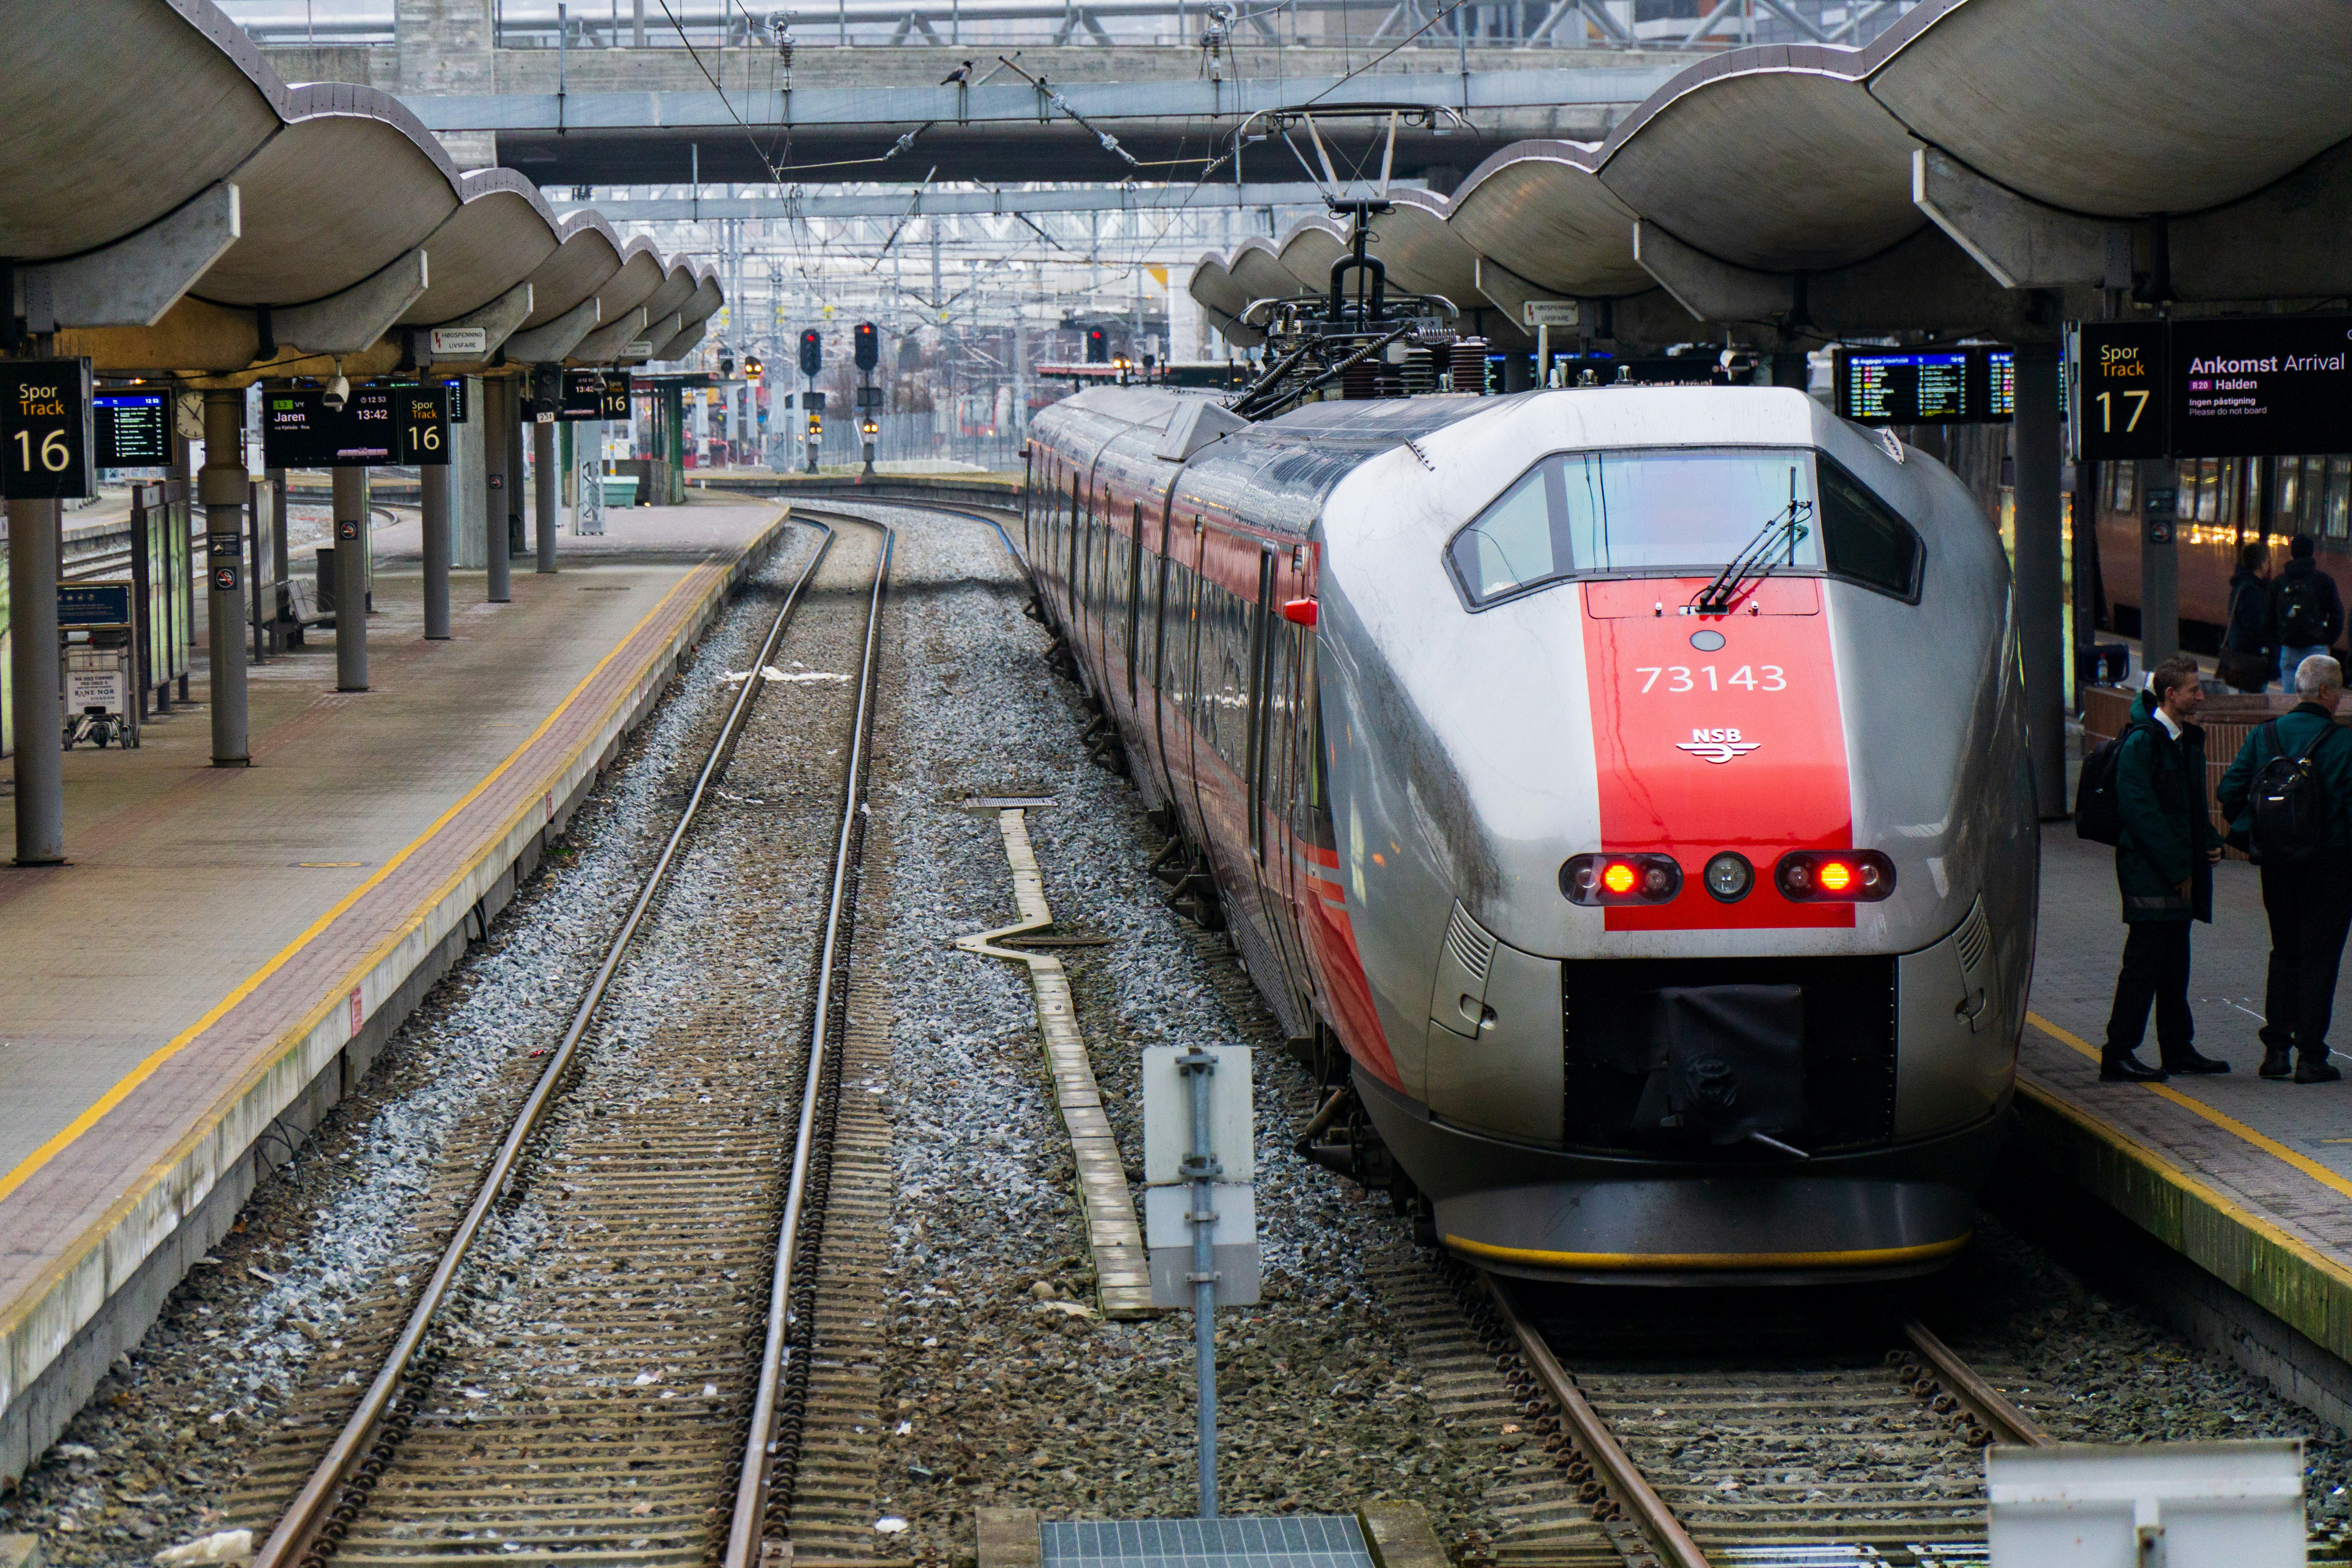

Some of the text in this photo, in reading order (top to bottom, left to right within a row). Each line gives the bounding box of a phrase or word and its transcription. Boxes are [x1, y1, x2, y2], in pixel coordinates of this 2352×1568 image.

[2101, 345, 2139, 362] Spor
[2101, 360, 2145, 377] Track
[2189, 352, 2345, 375] Ankomst Arrival
[19, 384, 57, 401] Spor
[2215, 379, 2258, 390] Halden
[20, 399, 64, 416] Track
[412, 400, 434, 411] Spor
[606, 396, 626, 411] 16
[2189, 396, 2256, 407] Ingen påstigning
[274, 412, 305, 422] Jaren
[357, 409, 388, 420] 13:42
[413, 410, 437, 419] Track
[2096, 390, 2150, 433] 17
[2244, 406, 2268, 414] board
[409, 426, 439, 450] 16
[14, 429, 70, 472] 16
[1636, 665, 1788, 693] 73143
[1692, 728, 1742, 743] NSB
